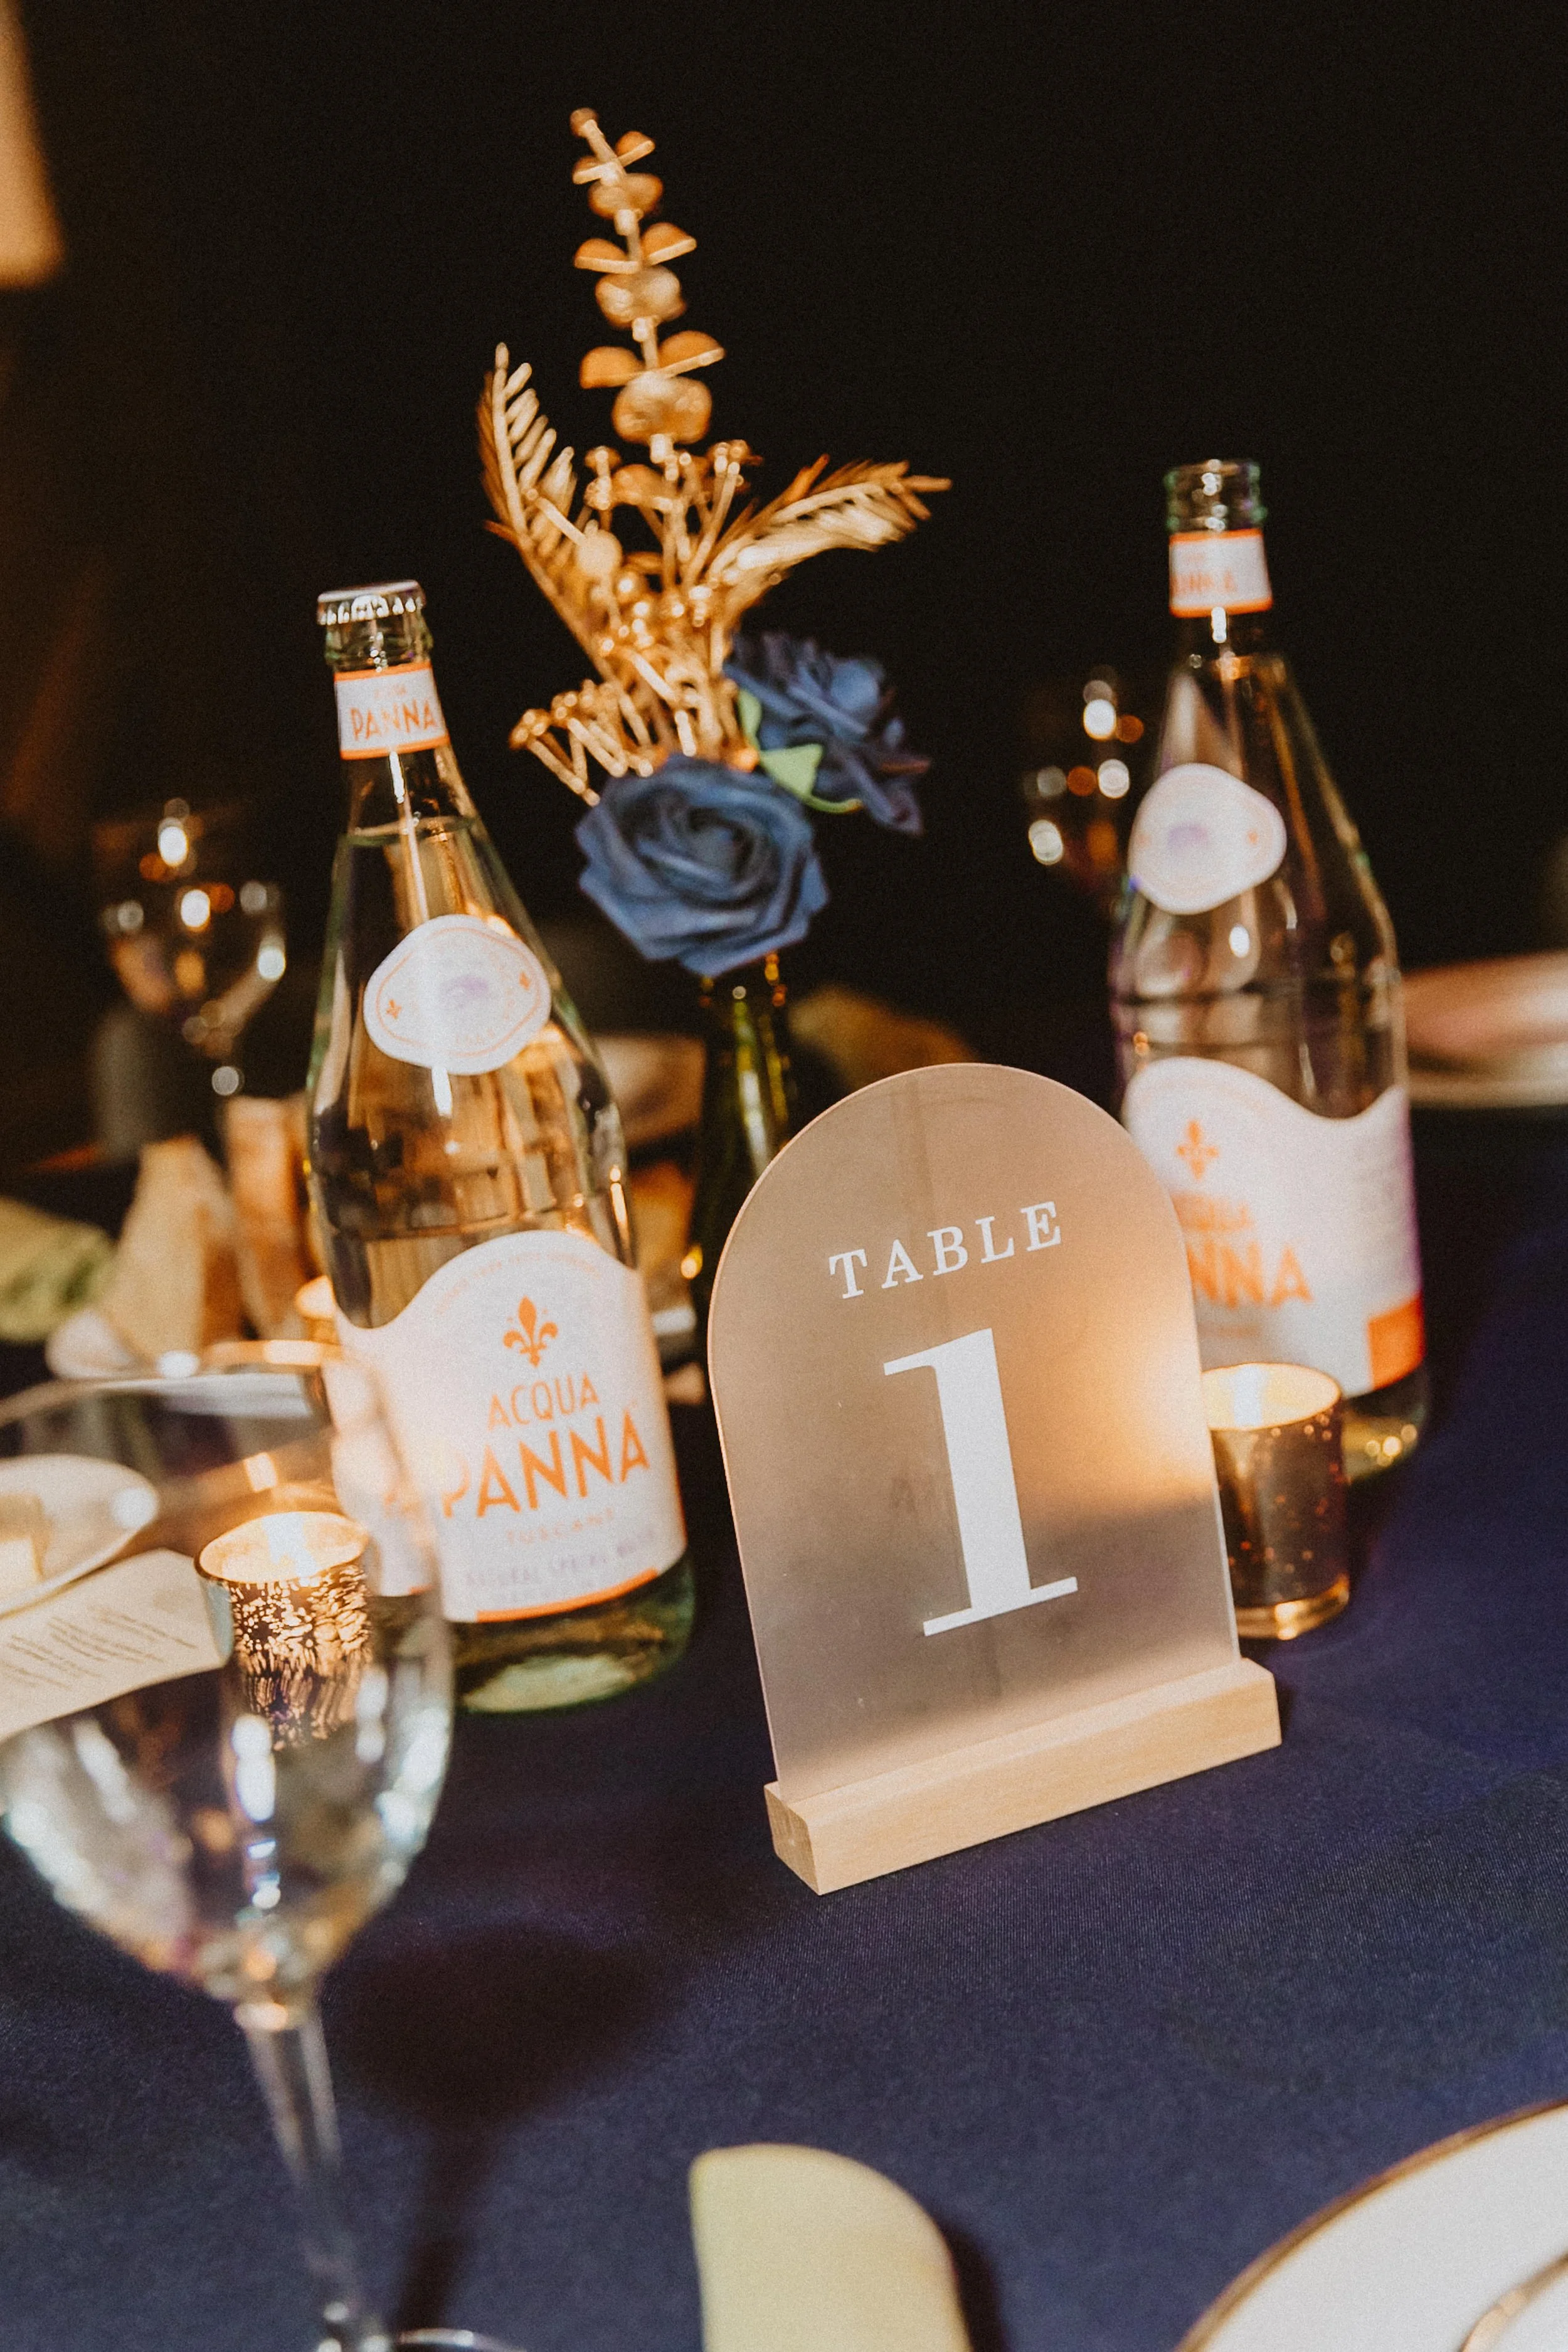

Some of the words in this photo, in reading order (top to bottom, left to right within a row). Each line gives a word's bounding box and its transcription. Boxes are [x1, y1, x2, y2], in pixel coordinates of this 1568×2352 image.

[349, 699, 437, 741] PANNA
[828, 1200, 1062, 1300] TABLE
[1185, 1237, 1315, 1310] NNA
[488, 1371, 599, 1430] ACQUA
[883, 1327, 1078, 1636] 1
